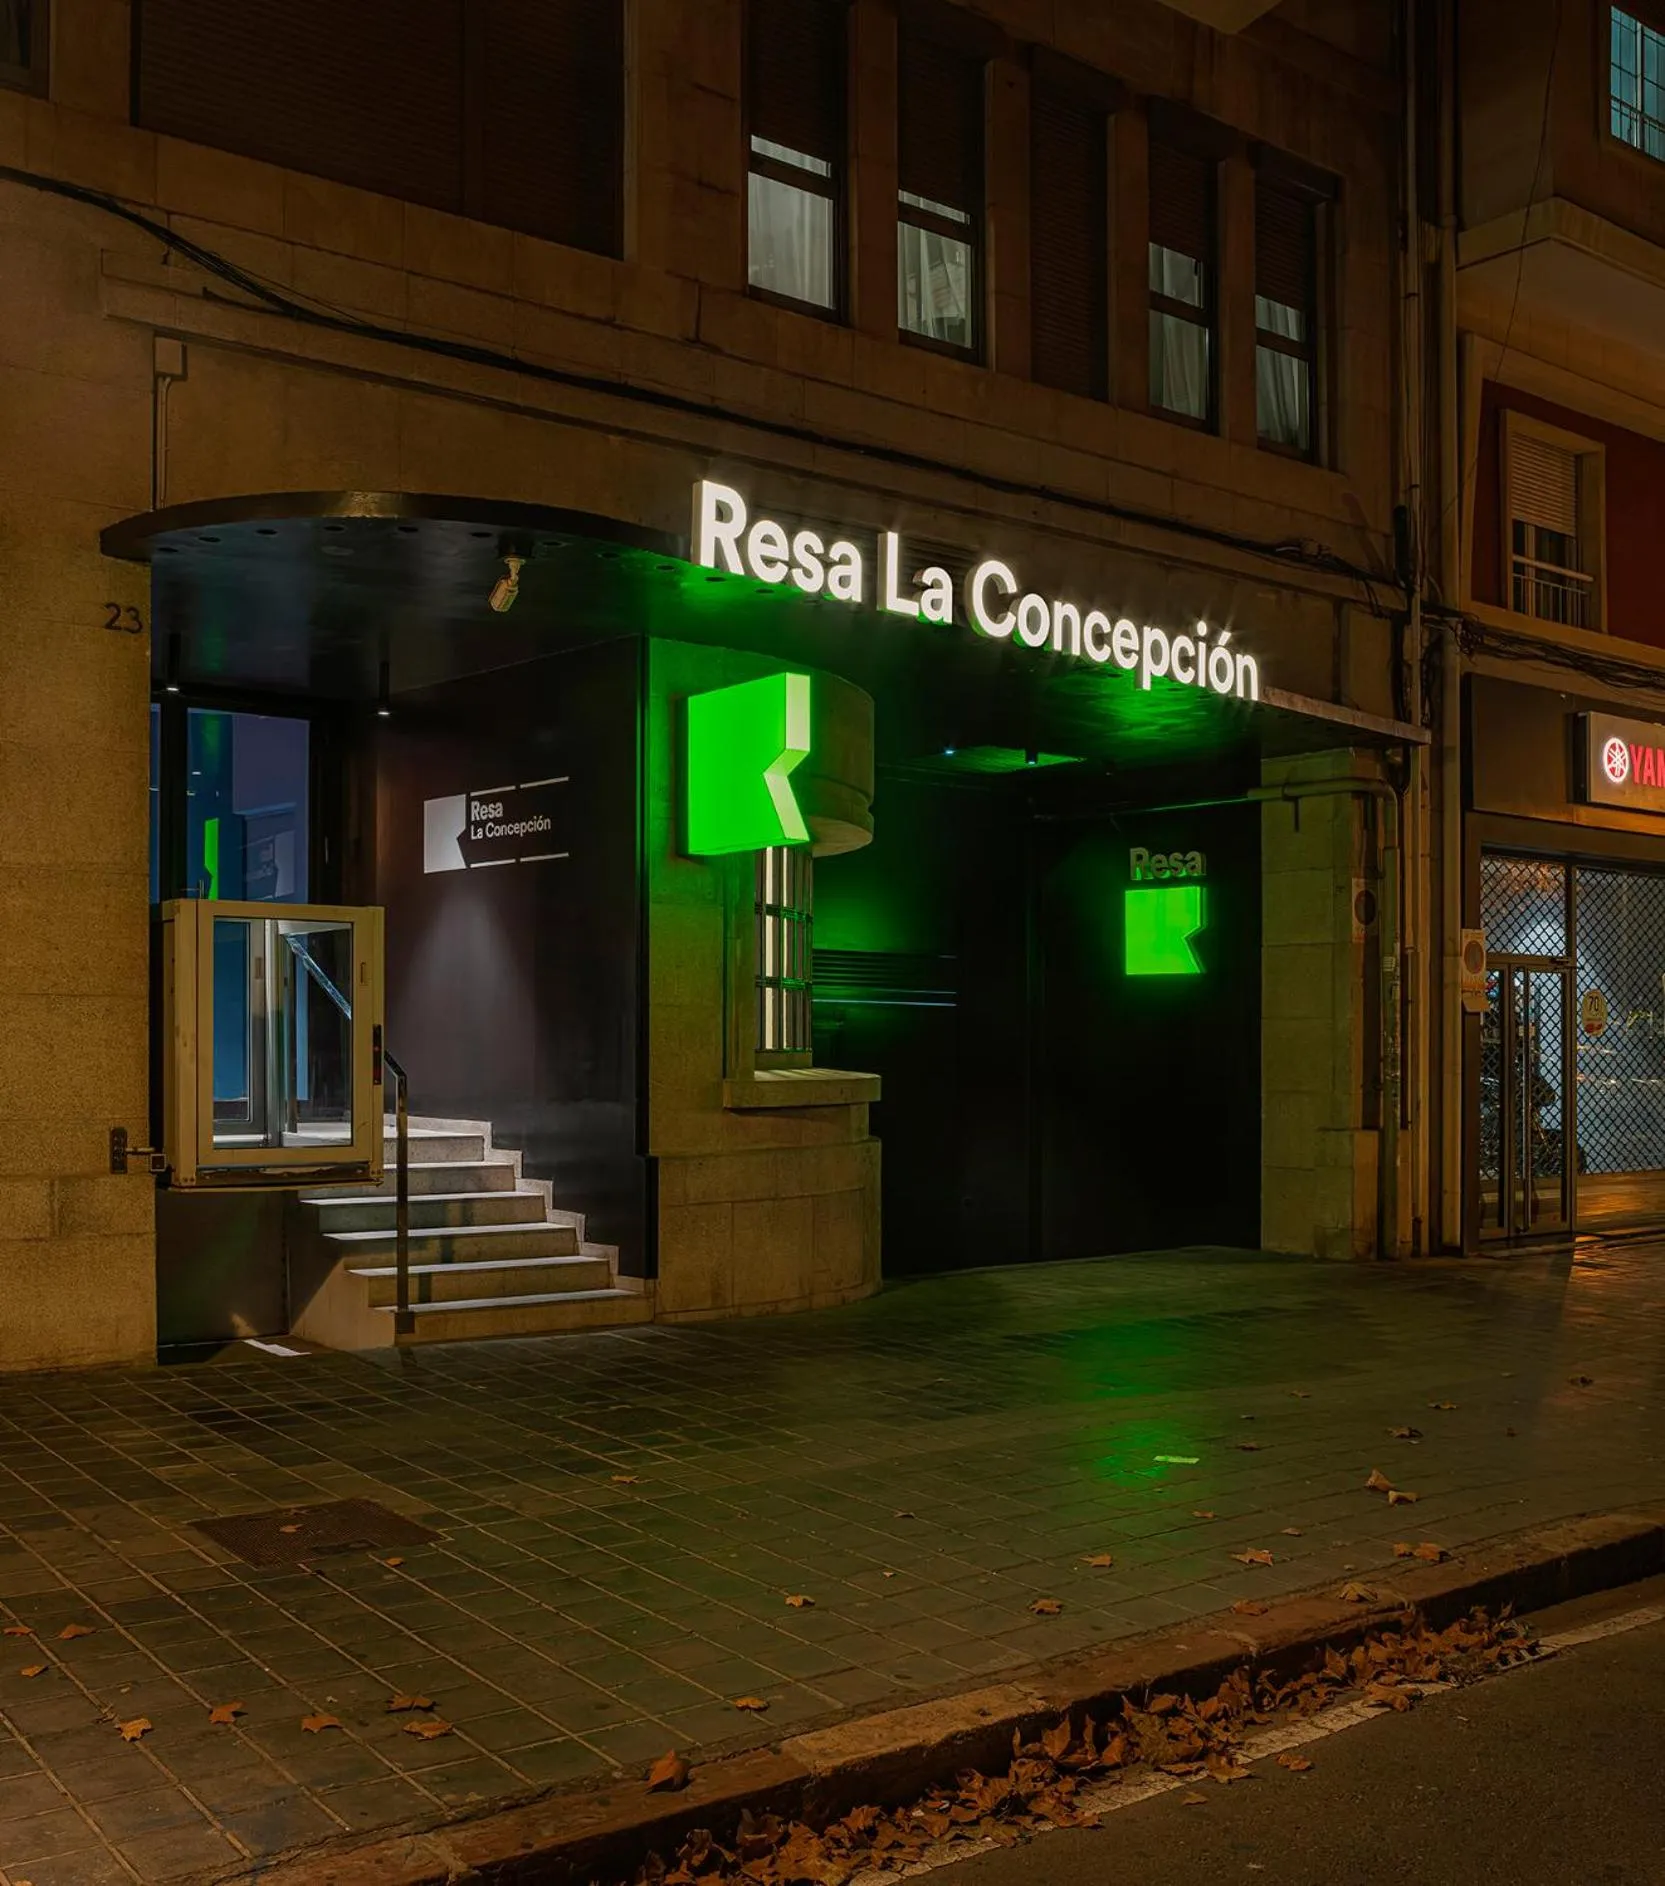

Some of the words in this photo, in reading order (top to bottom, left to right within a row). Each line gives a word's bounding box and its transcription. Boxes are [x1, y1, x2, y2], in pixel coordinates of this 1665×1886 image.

[693, 480, 863, 602] Resa
[878, 531, 953, 624] La
[969, 560, 1259, 701] Concepción
[103, 602, 143, 634] 23
[470, 801, 503, 822] Resa
[470, 823, 483, 840] La
[485, 815, 551, 838] Concepción
[1130, 847, 1206, 881] Resa
